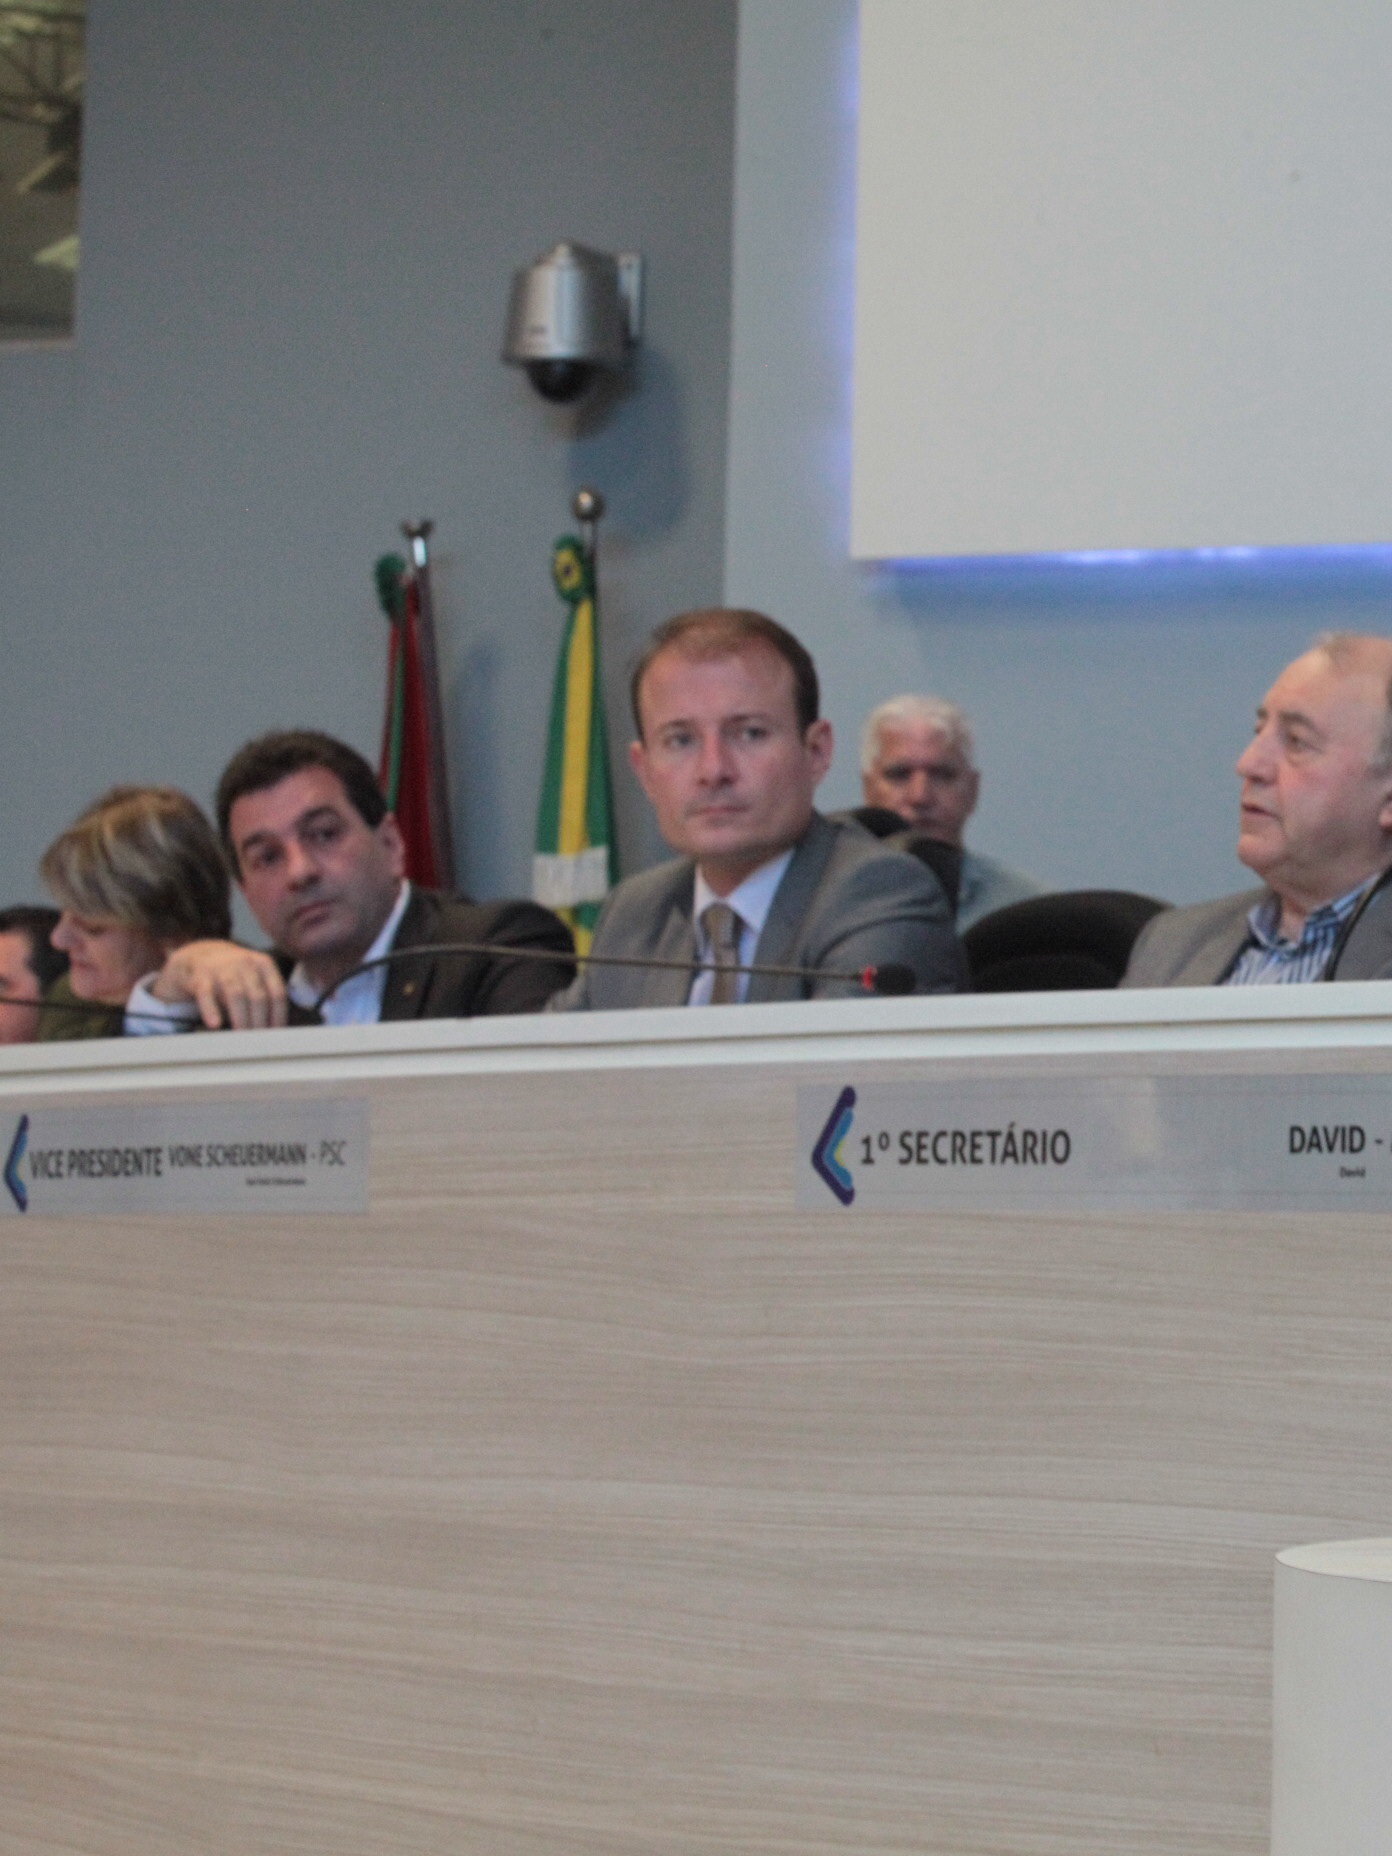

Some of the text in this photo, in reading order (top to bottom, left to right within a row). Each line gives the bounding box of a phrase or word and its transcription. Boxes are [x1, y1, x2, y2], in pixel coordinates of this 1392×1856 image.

[898, 1121, 1072, 1165] SECRETÁRIO
[1288, 1124, 1366, 1155] DAVID
[29, 1147, 163, 1179] VICE PRESIDENTE
